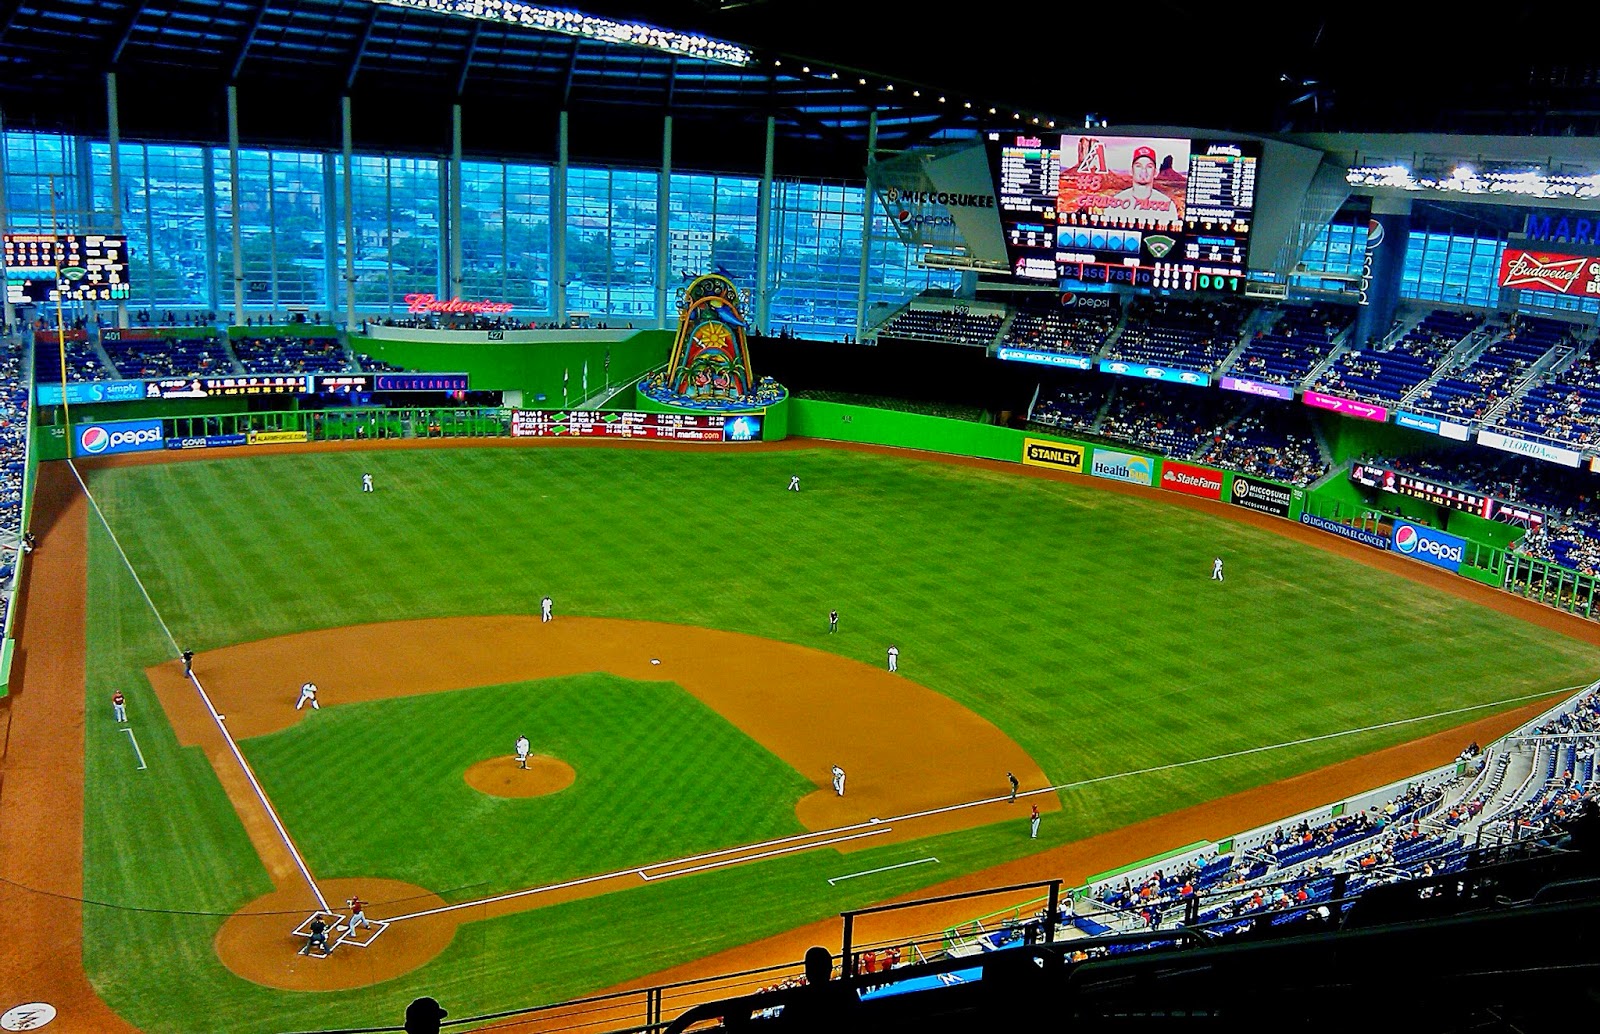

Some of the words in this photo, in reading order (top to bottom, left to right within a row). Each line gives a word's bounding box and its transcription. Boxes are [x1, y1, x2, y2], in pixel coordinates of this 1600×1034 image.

[1077, 175, 1102, 191] #8
[902, 190, 994, 208] MICCOSUKEE
[1077, 195, 1130, 209] GERARDO
[1134, 200, 1170, 211] PARRA
[915, 215, 956, 230] pepsi
[1058, 265, 1065, 275] 1
[1065, 266, 1071, 275] 2
[1073, 267, 1079, 276] 3
[1084, 268, 1090, 277] 4
[1090, 269, 1097, 278] 5
[1098, 269, 1105, 279] 6
[1109, 270, 1116, 279] 7
[1117, 271, 1124, 280] 8
[1126, 271, 1132, 280] 9
[1358, 250, 1373, 305] pepsi
[1508, 259, 1581, 280] Budweiser
[1200, 275, 1209, 288] 0
[1214, 276, 1224, 290] 0
[1230, 278, 1238, 291] 1
[404, 293, 514, 313] Budweiser
[1079, 297, 1109, 308] pepsi
[104, 332, 120, 340] 401
[488, 332, 502, 340] 427
[107, 383, 138, 393] simply
[378, 377, 466, 389] CLEVELANDER
[110, 427, 162, 447] pepsi
[182, 438, 206, 446] GOYA
[677, 431, 719, 440] marlins.com
[1031, 447, 1078, 464] STANLEY
[1502, 438, 1546, 457] FLORIDA
[1249, 491, 1266, 500] RESORT
[1250, 485, 1290, 501] MICCOSUKEE
[1240, 500, 1280, 514] MICCOSUKEE.COM
[1310, 516, 1324, 528] LIGA
[1324, 522, 1350, 537] CONTRA
[1350, 530, 1357, 539] EL
[1358, 533, 1384, 548] CANCER
[1418, 538, 1462, 563] pepsi
